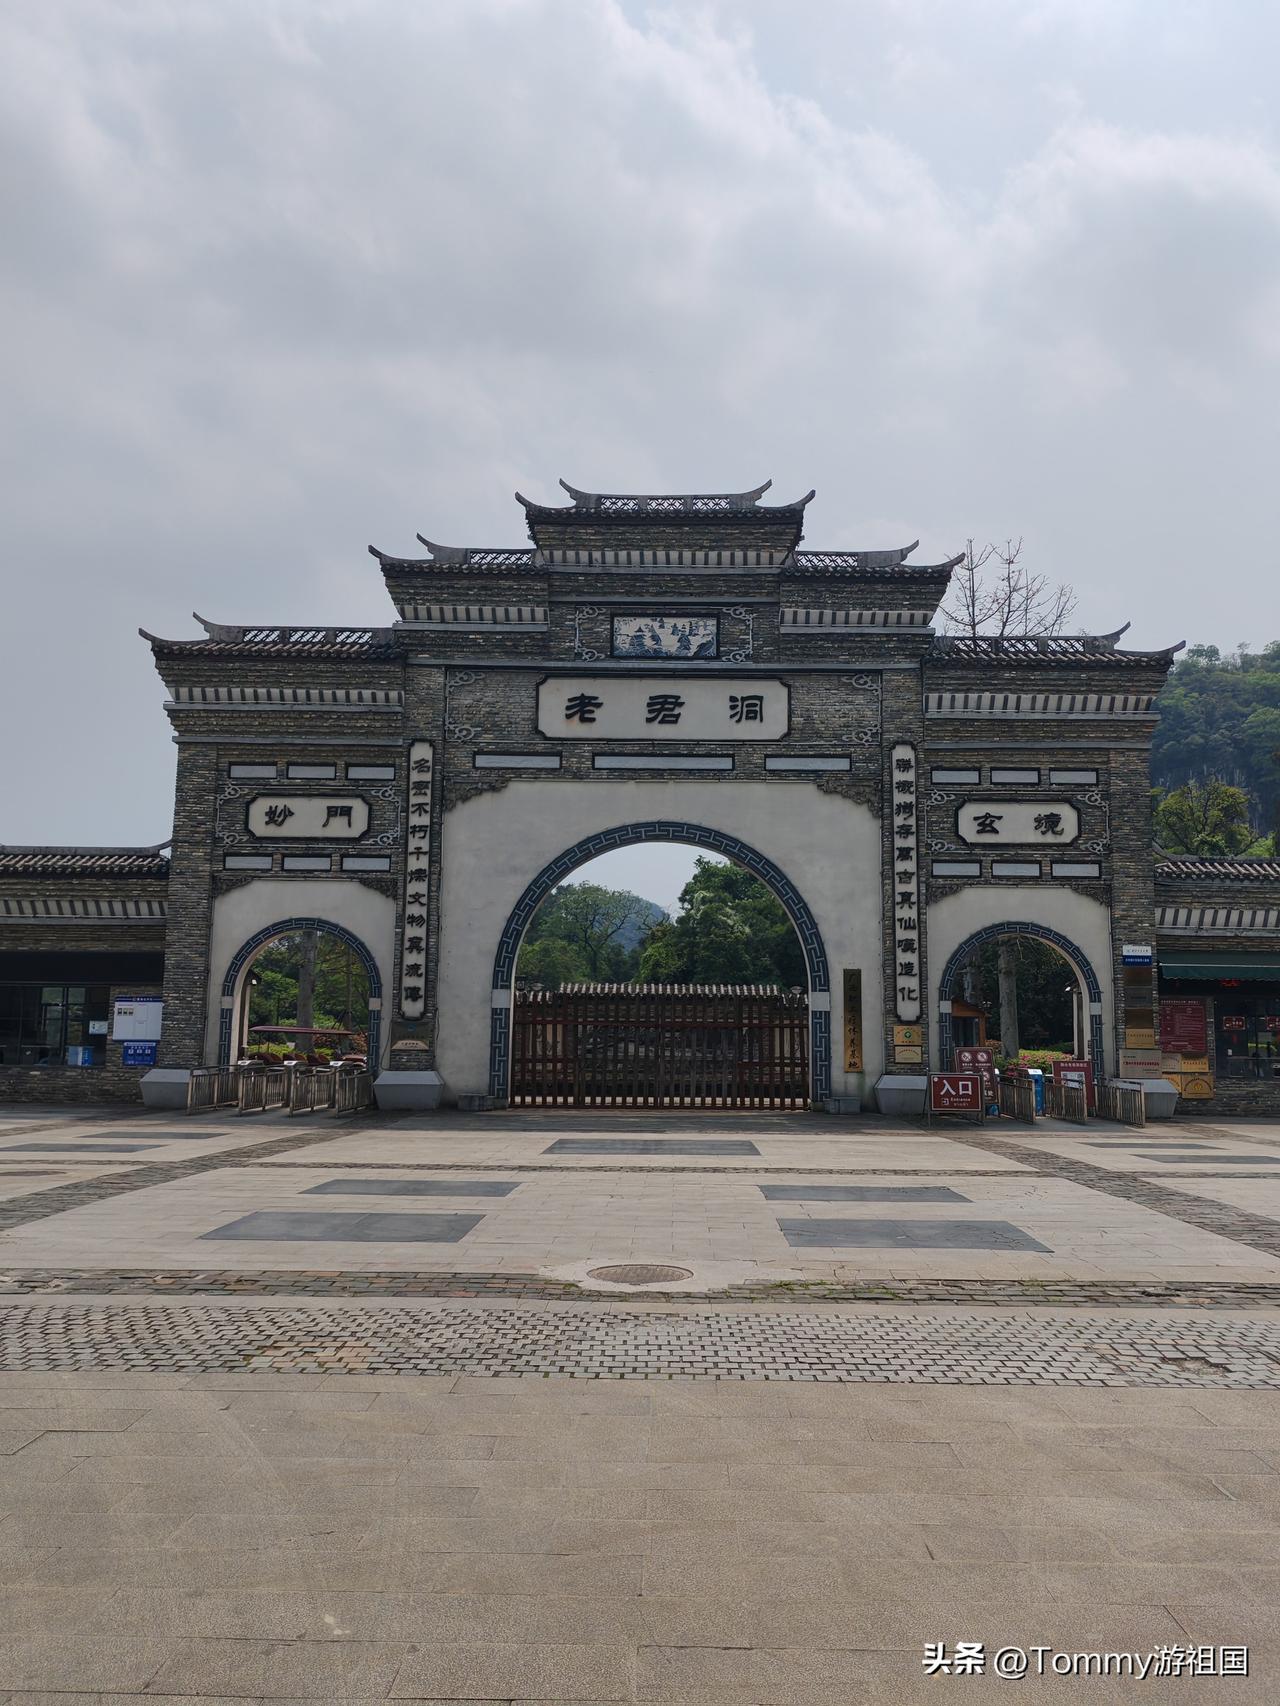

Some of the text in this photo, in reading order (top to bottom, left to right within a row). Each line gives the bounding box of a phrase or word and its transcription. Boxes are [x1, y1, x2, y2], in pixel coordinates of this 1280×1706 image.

[565, 693, 764, 724] 老君洞
[264, 804, 353, 828] 妙門
[973, 812, 1066, 836] 玄境
[940, 1079, 973, 1096] 入口
